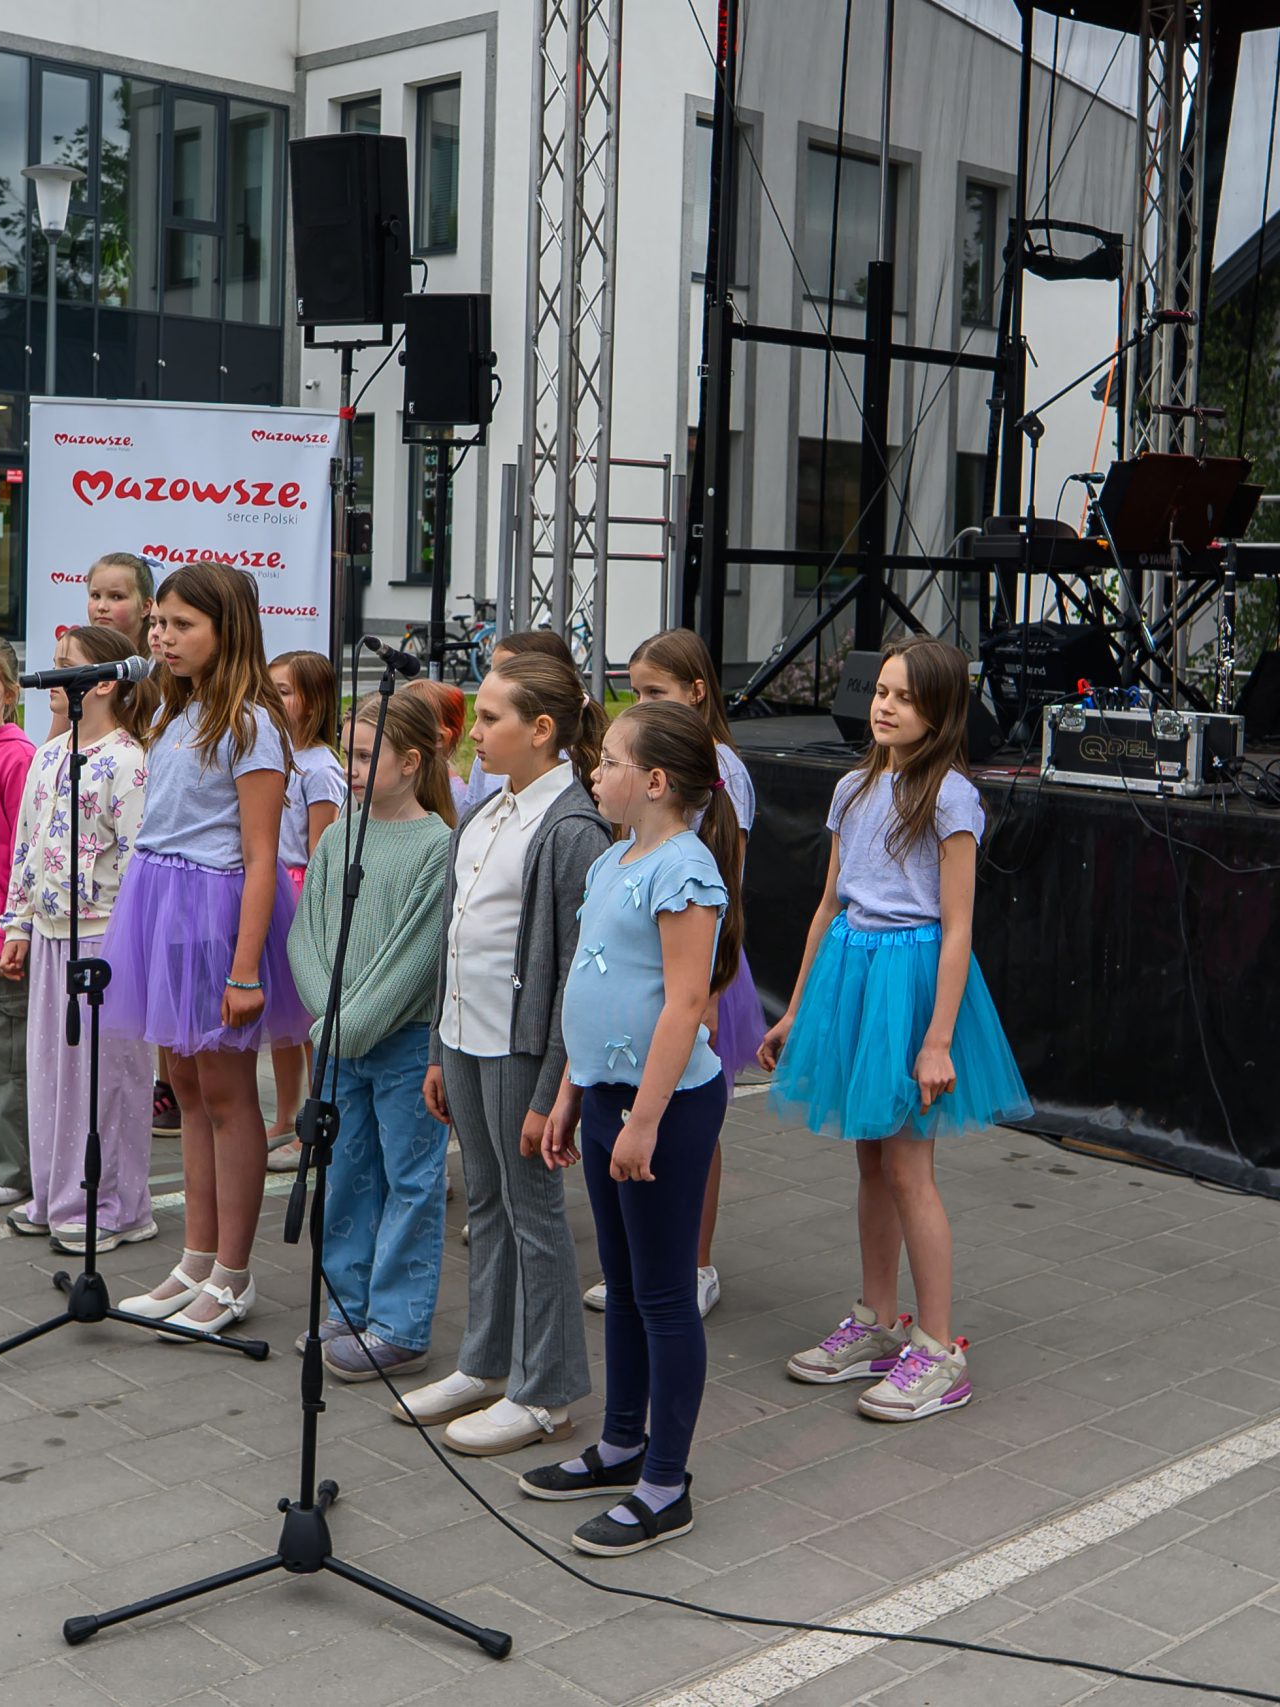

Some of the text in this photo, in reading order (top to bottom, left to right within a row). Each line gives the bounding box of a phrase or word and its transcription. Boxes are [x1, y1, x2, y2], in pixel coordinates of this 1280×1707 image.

[54, 433, 134, 446] Mazowsze.
[251, 430, 330, 444] Mazowsze.
[72, 470, 307, 510] Mazowsze.
[227, 512, 298, 525] serce Polski
[51, 572, 89, 585] Mazo
[257, 570, 280, 579] Polski
[258, 605, 320, 617] azowsze.
[1016, 664, 1047, 676] Rland
